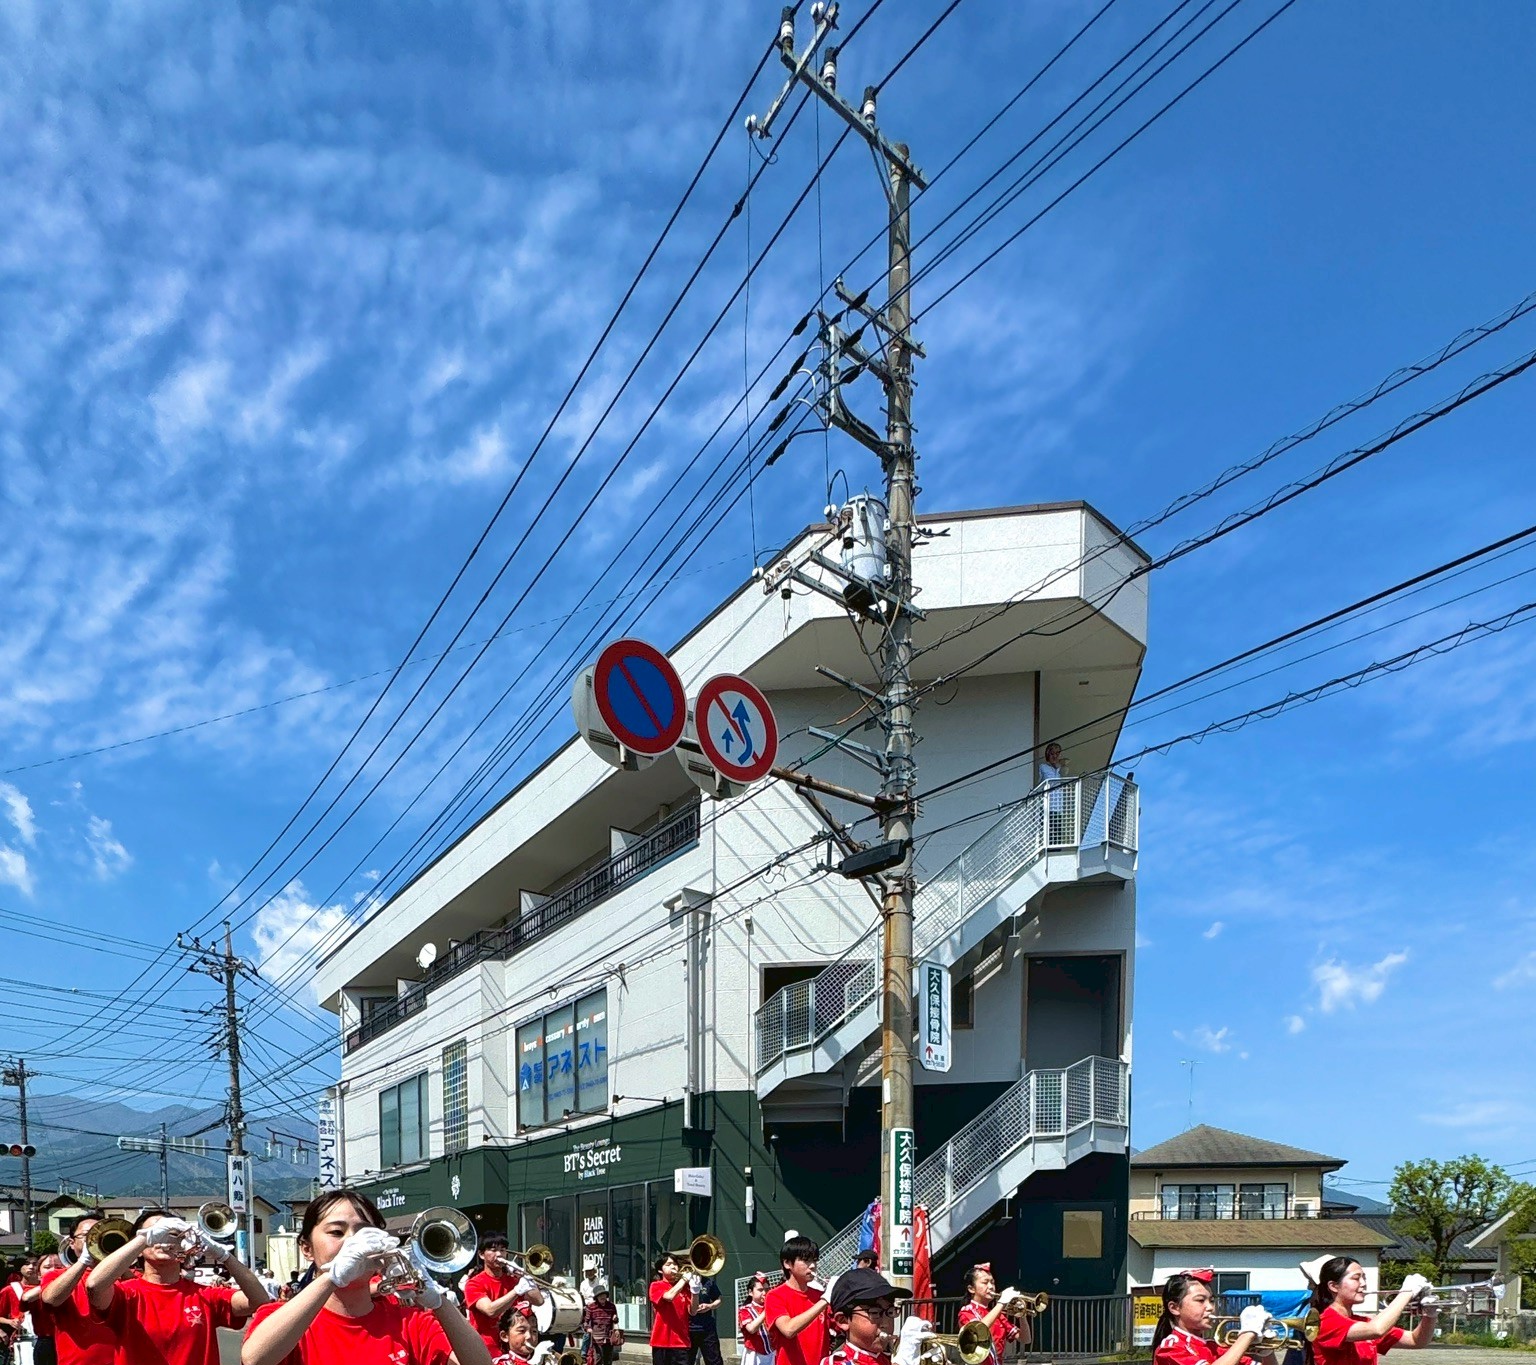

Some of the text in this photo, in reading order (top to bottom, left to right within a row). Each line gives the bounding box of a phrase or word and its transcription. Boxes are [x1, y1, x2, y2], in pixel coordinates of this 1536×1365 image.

[929, 969, 941, 1044] 大久保接骨院
[563, 1144, 622, 1173] BT's Secret
[898, 1132, 912, 1224] 大久保接骨院
[376, 1193, 406, 1210] Black Tree
[583, 1216, 604, 1231] HAIR
[582, 1230, 605, 1246] CARE
